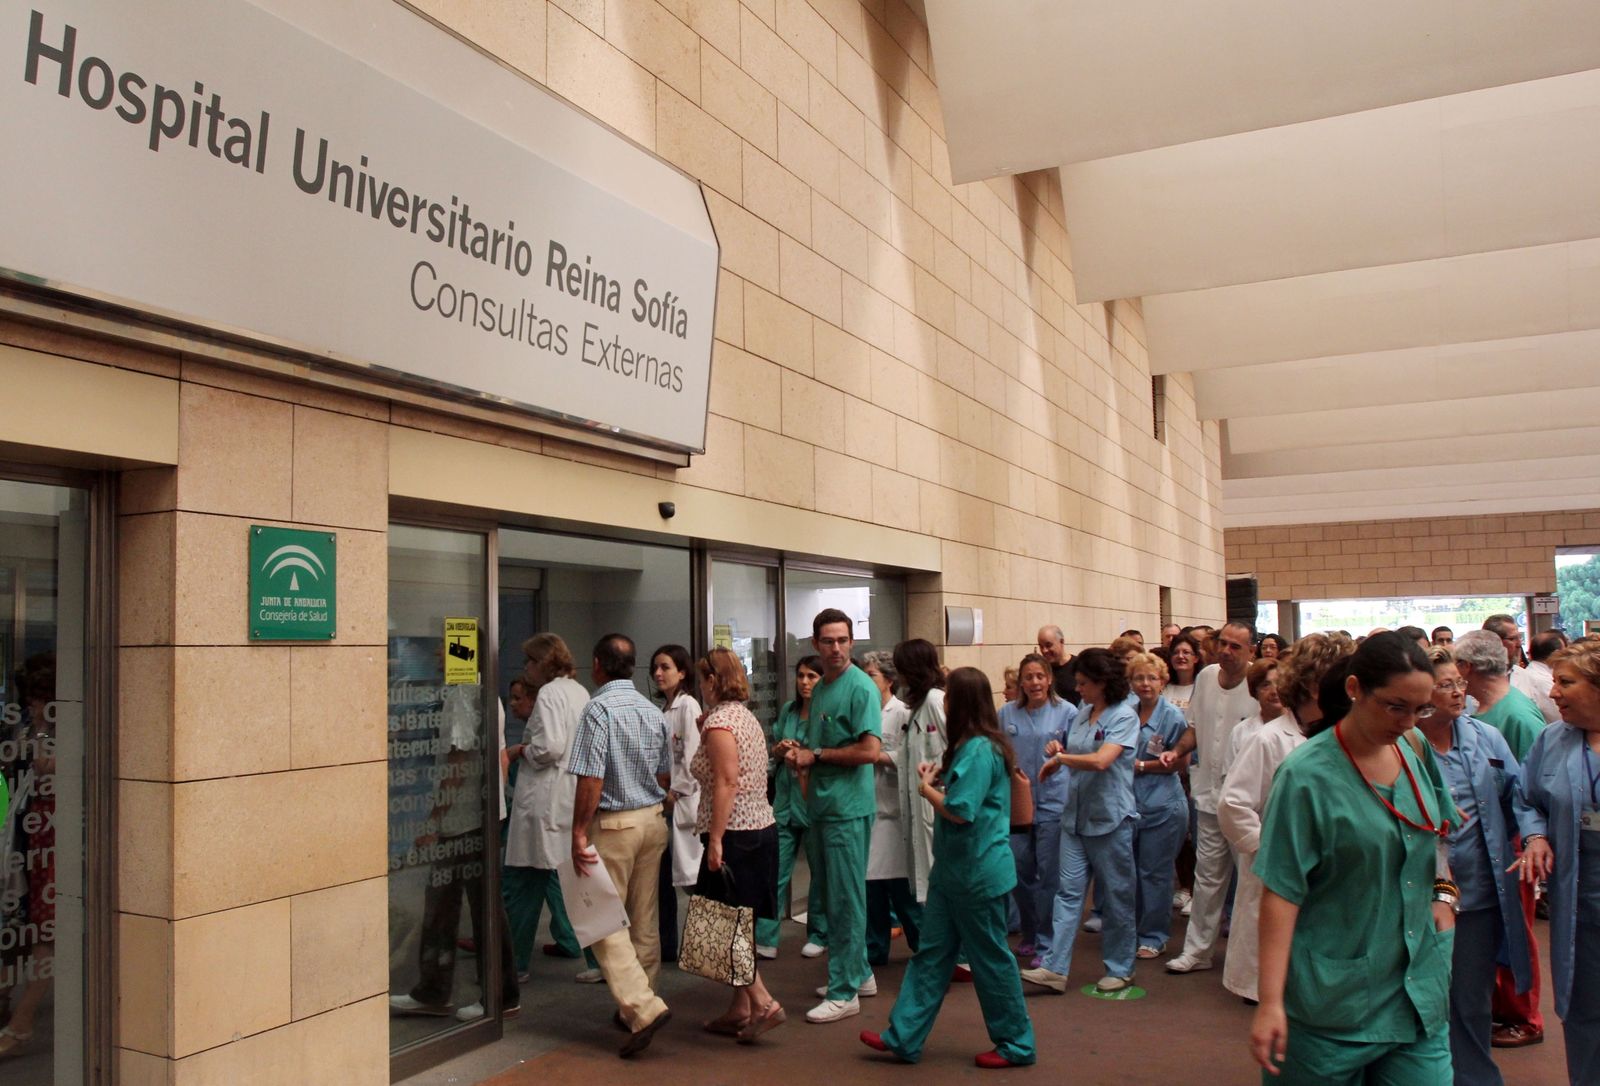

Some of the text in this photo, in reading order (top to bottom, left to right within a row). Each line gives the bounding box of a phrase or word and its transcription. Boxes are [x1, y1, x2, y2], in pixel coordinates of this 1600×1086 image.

[24, 10, 688, 339] Hospital Universitario Reina Sofía
[409, 259, 684, 393] Consultas Externas
[261, 596, 281, 606] JUNTA
[283, 597, 292, 607] DE
[298, 610, 308, 621] de
[309, 610, 328, 622] Salud
